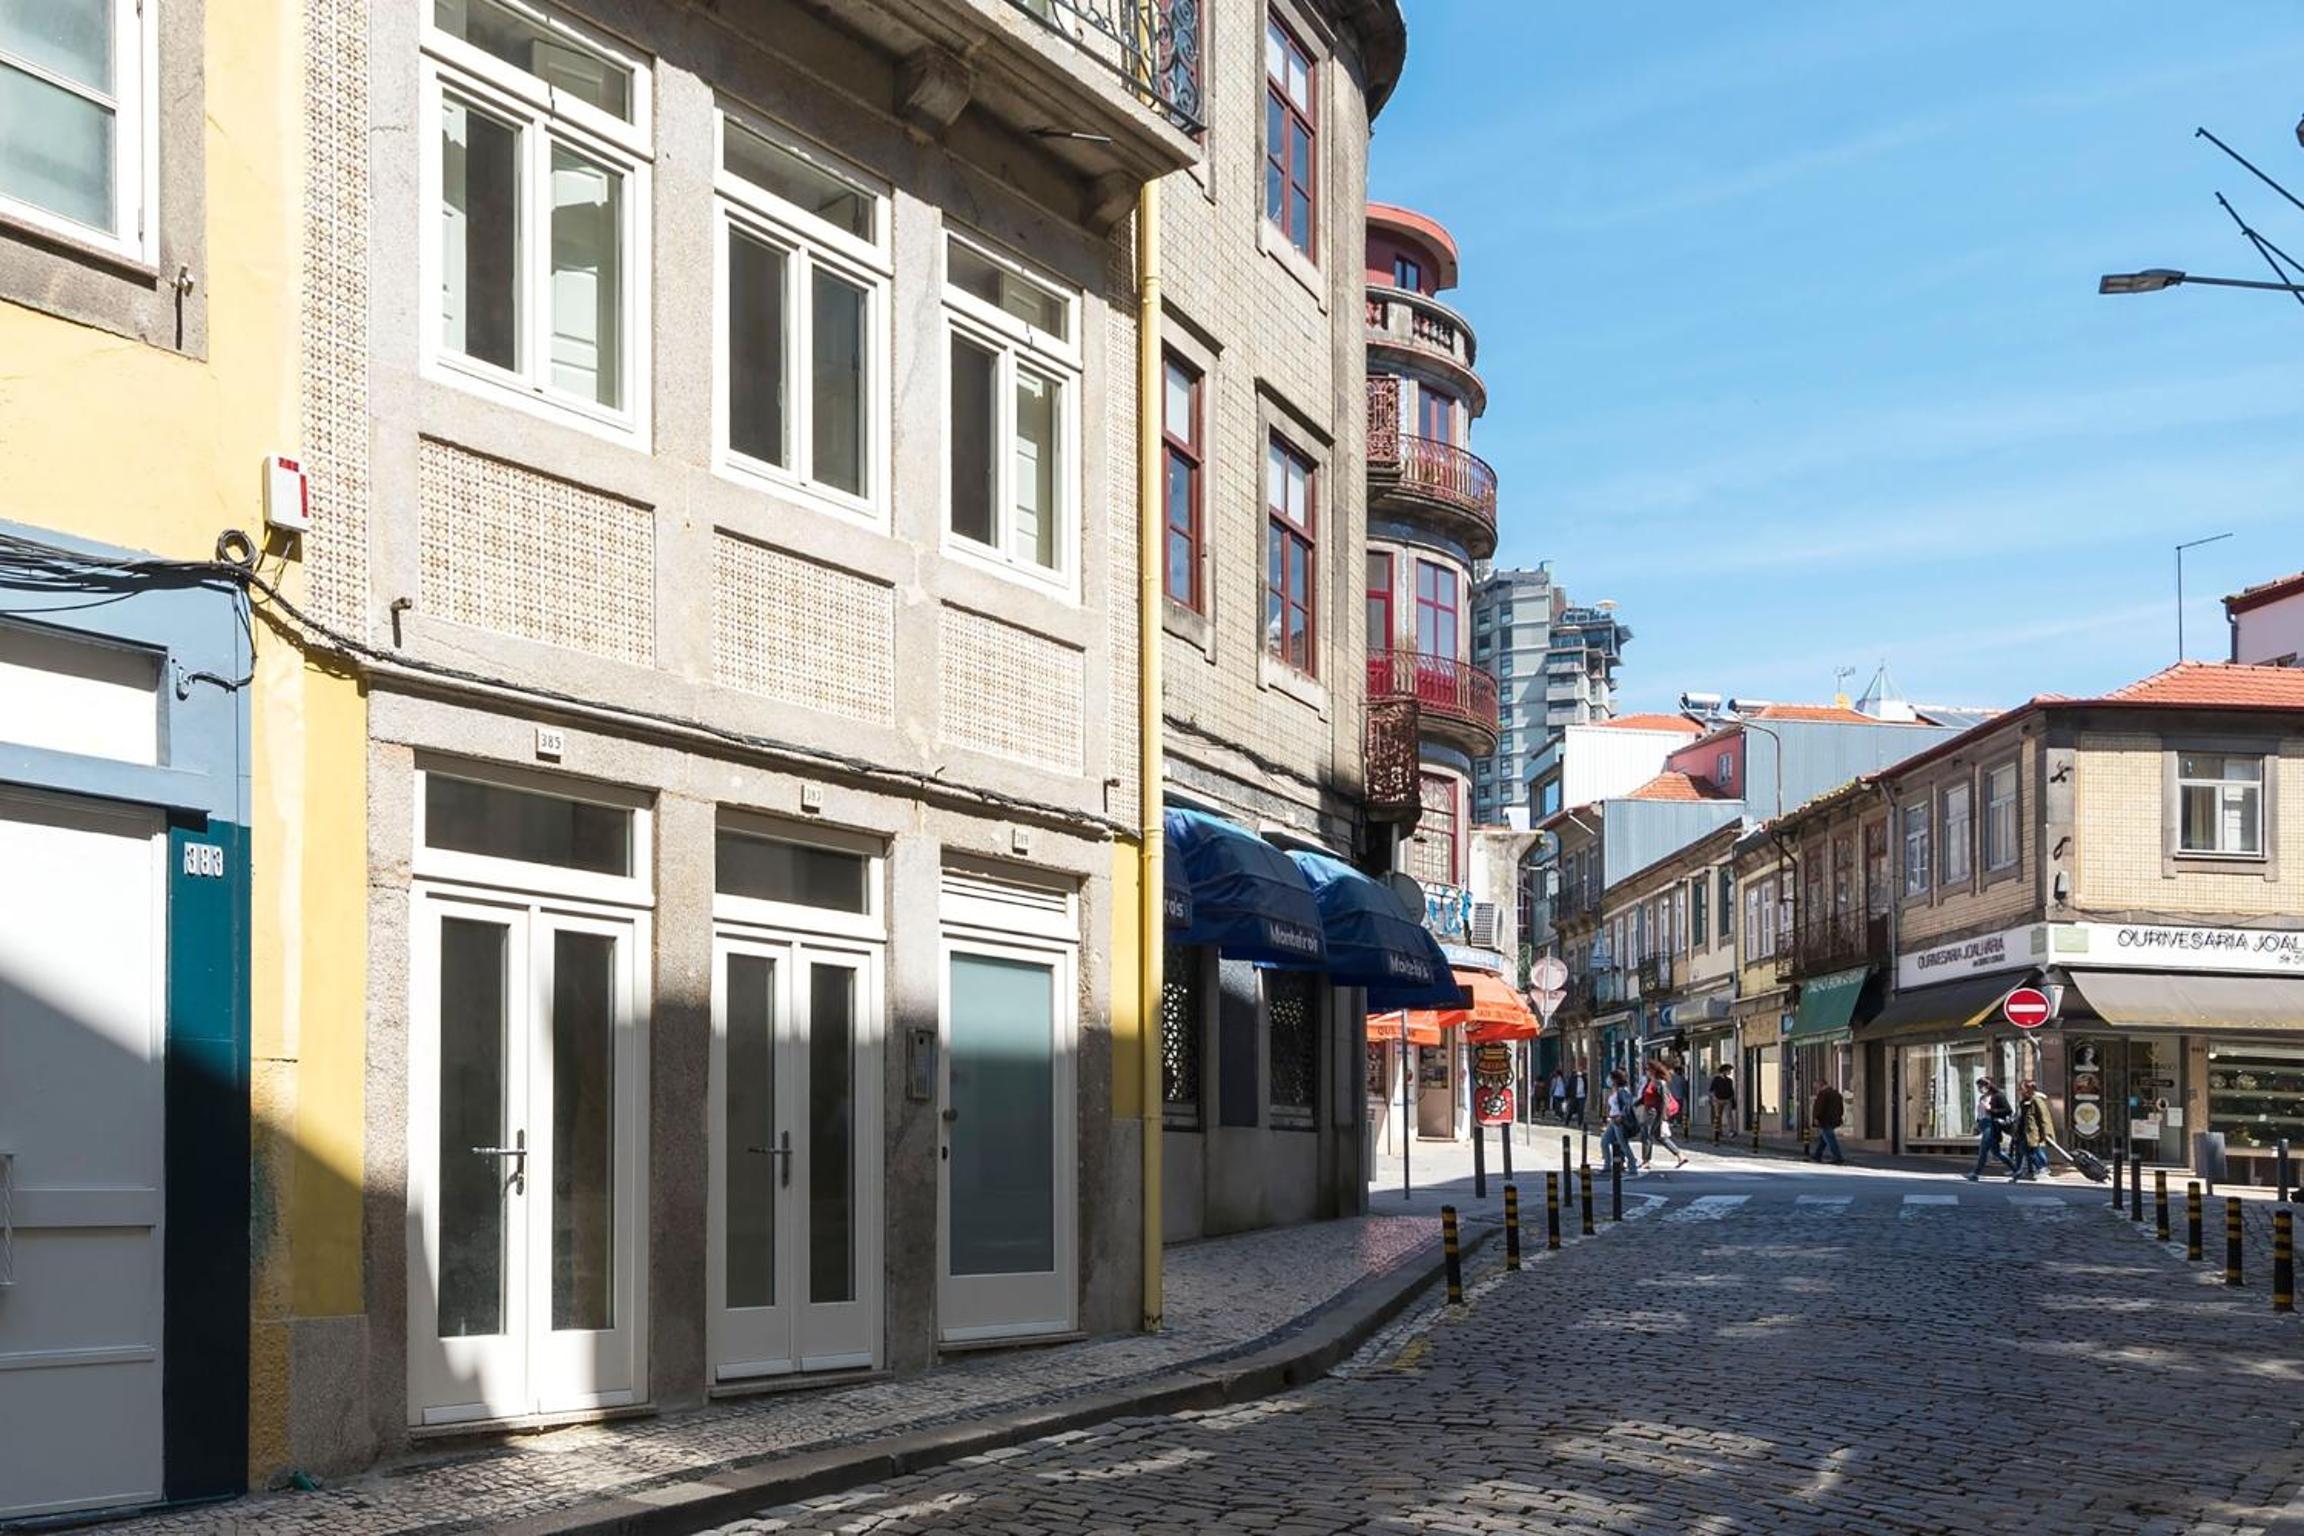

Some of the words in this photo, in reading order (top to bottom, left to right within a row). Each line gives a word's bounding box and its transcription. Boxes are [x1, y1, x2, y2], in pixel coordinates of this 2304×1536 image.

[541, 733, 561, 750] 385
[186, 843, 223, 877] 383
[2117, 927, 2249, 951] OURIVESARIA
